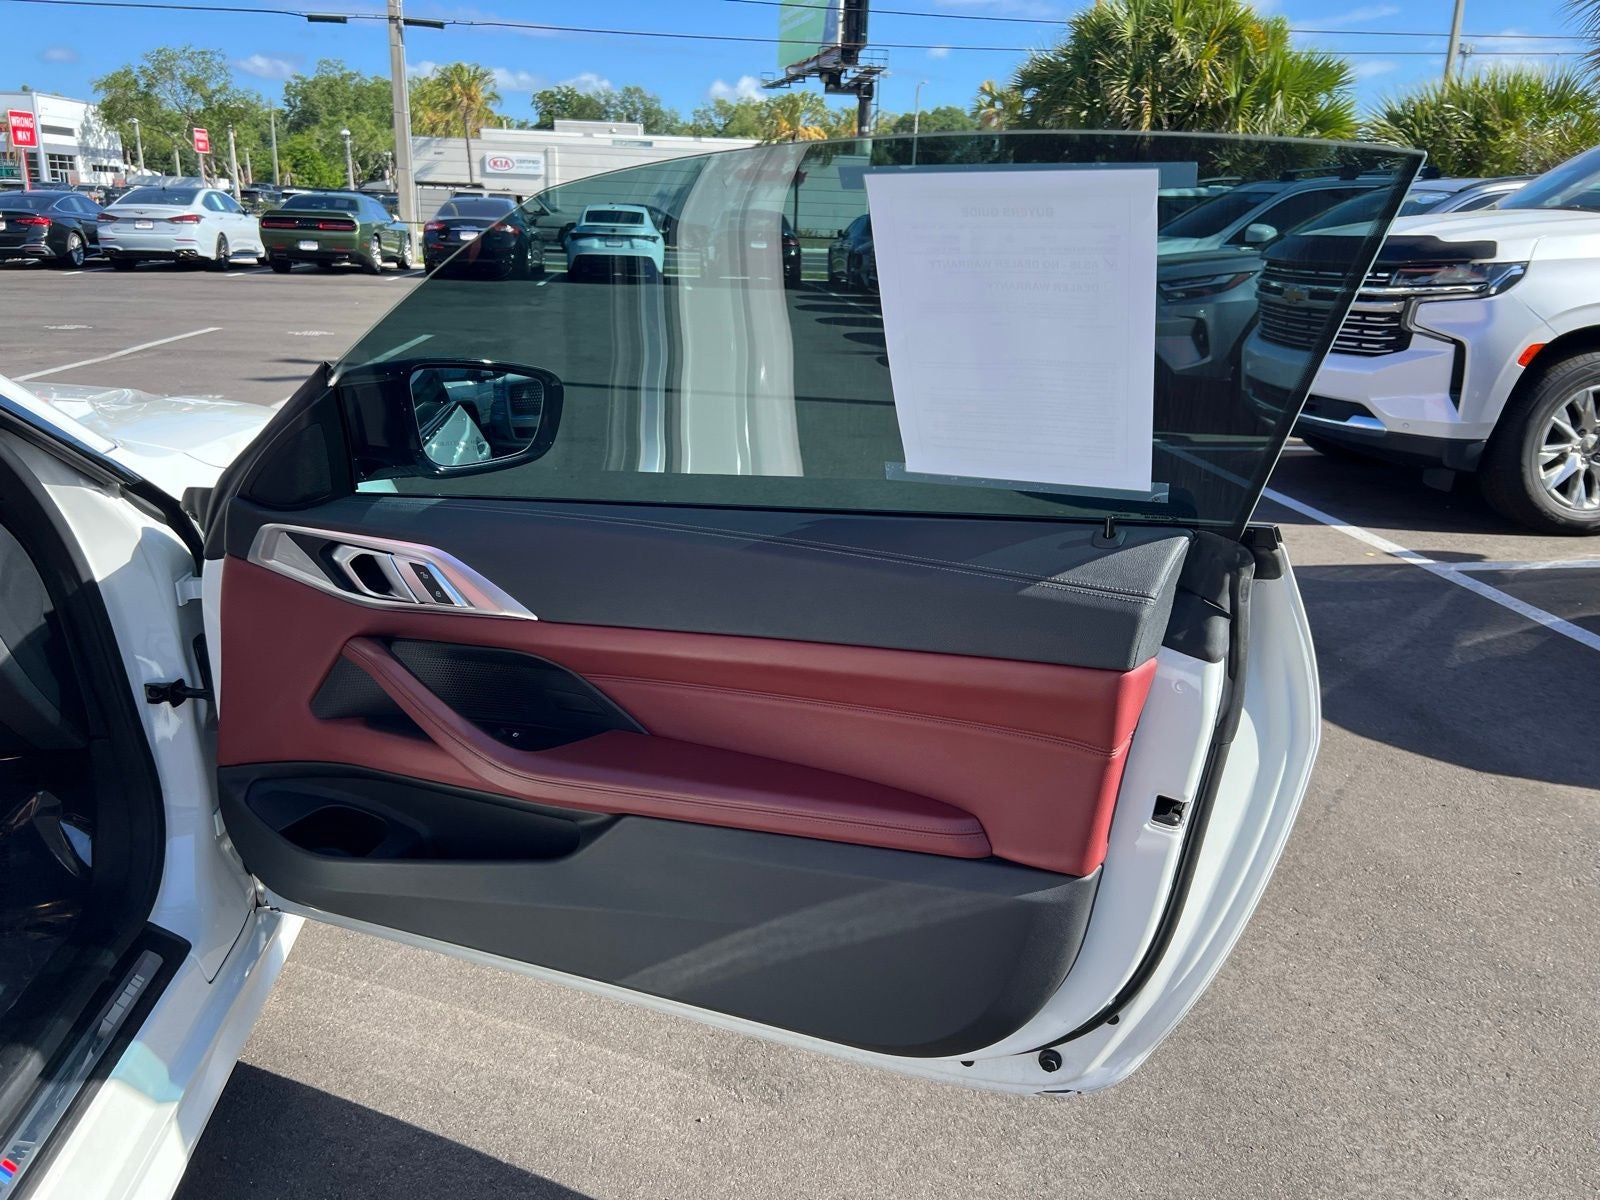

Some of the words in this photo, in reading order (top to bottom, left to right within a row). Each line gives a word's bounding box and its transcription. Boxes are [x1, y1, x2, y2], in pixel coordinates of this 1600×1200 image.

[10, 116, 34, 128] WRONG
[16, 130, 31, 142] WAY
[492, 160, 511, 168] KIA
